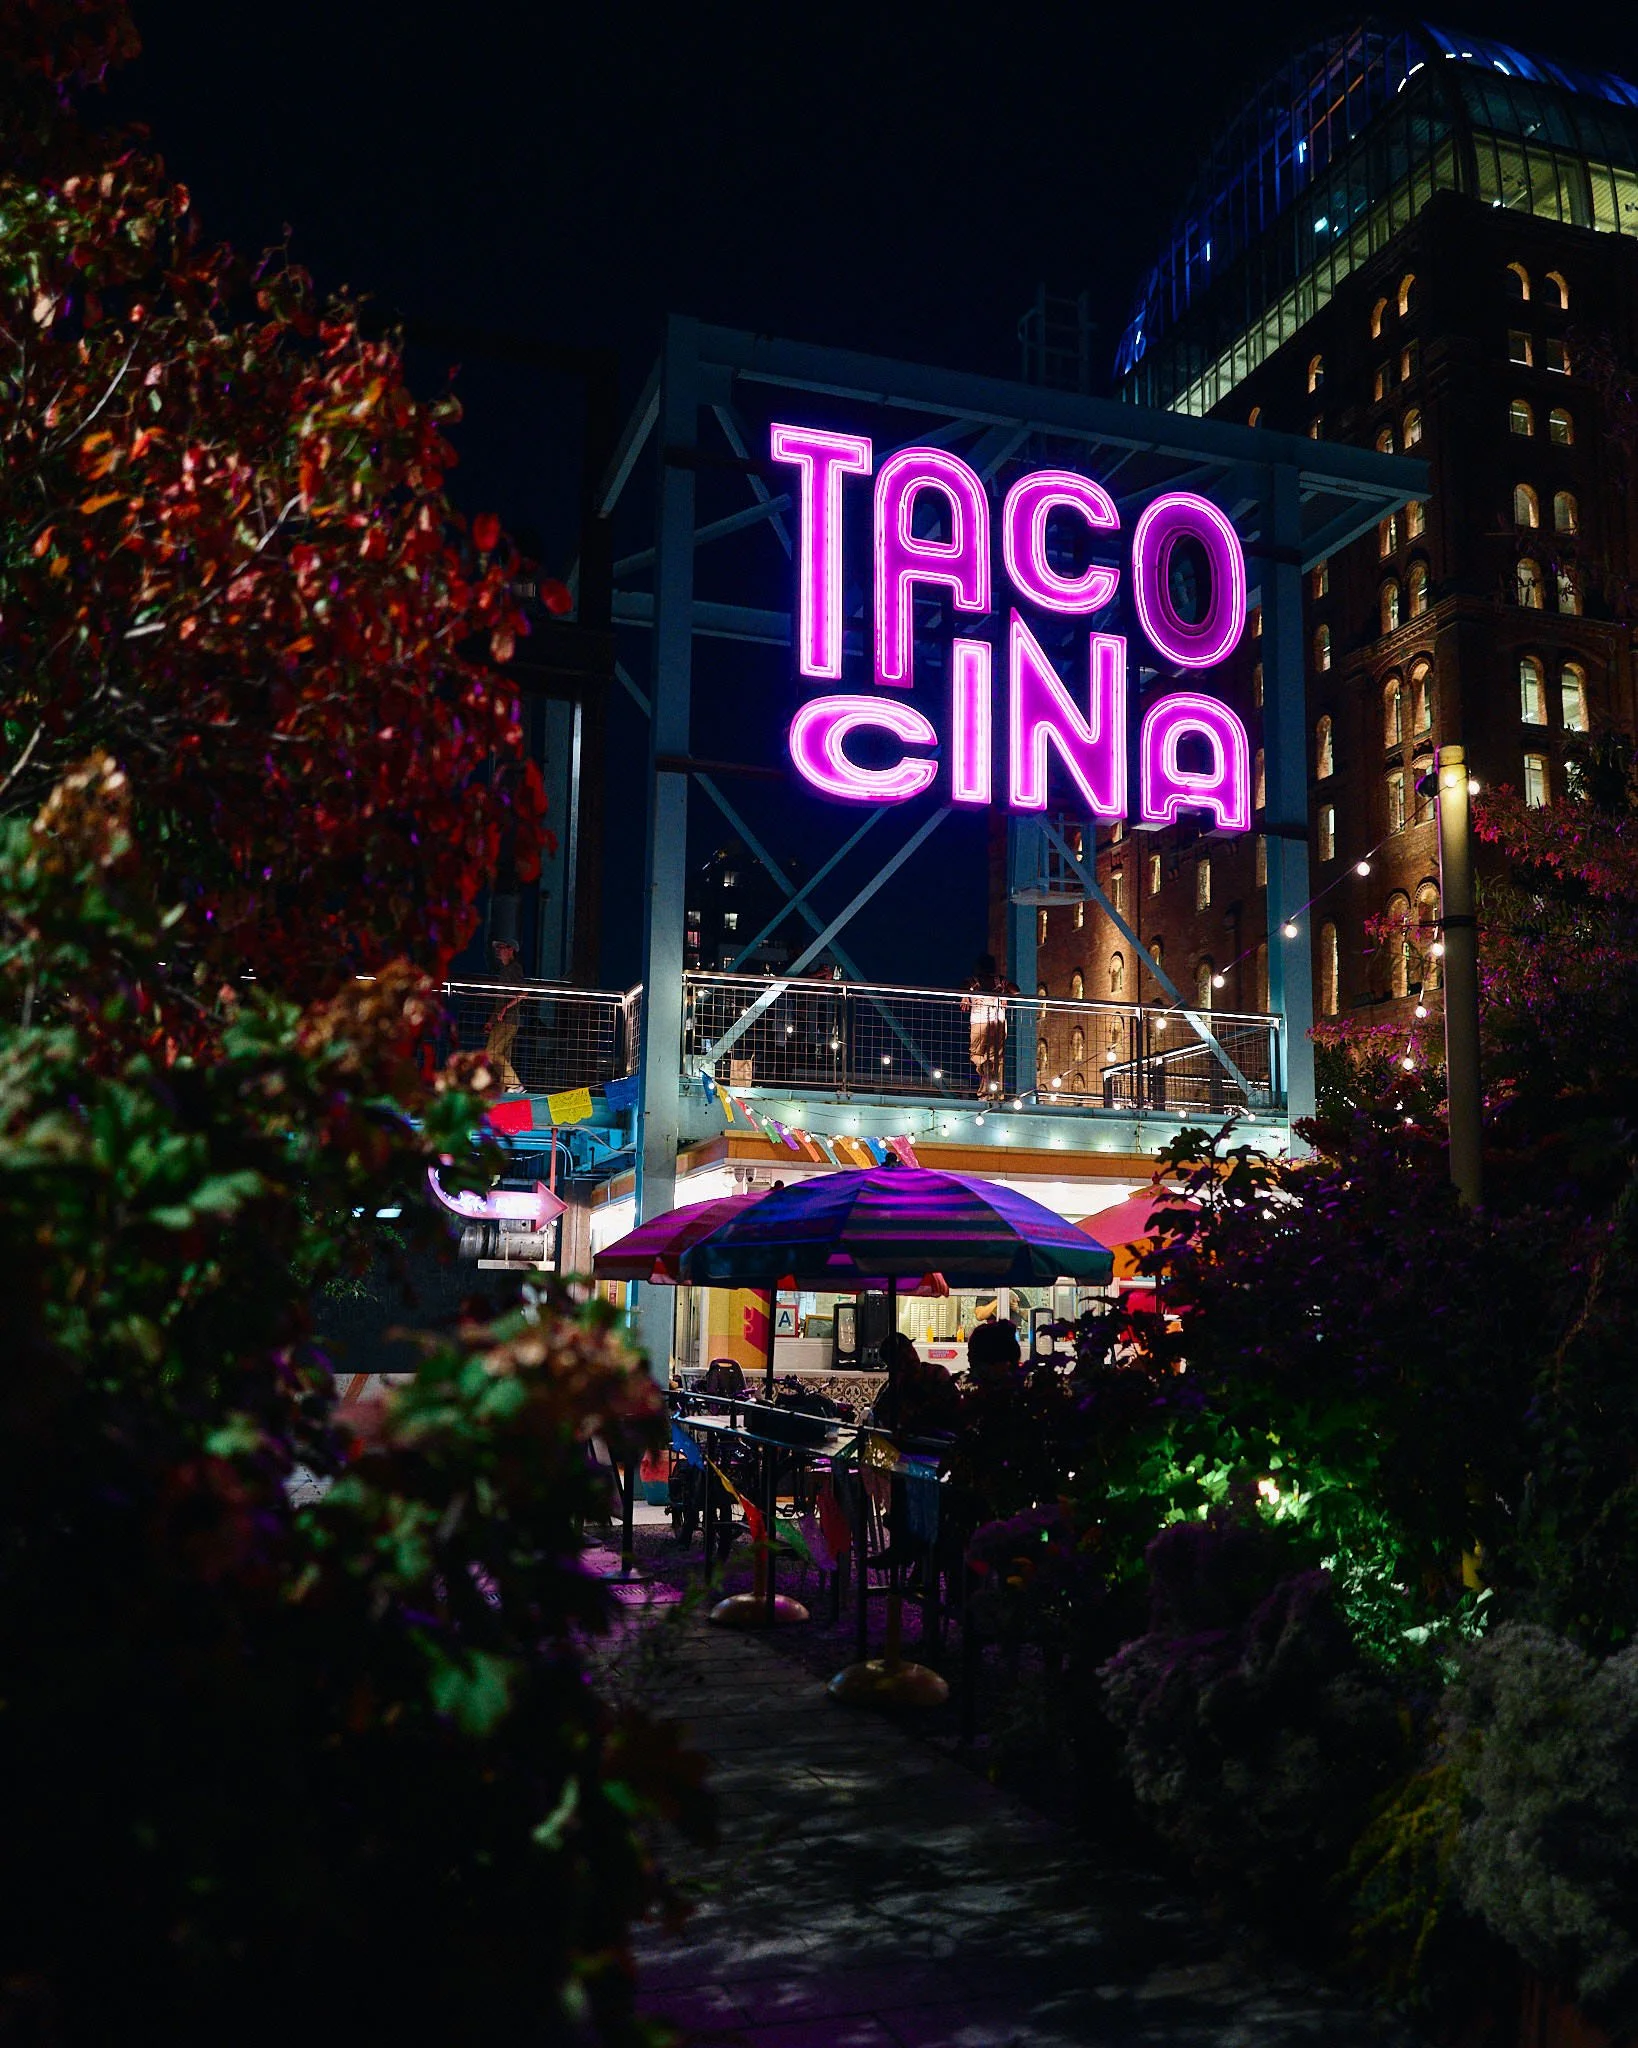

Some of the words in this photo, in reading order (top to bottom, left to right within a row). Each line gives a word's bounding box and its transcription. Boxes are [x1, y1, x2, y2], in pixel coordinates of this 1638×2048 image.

[770, 422, 1247, 689] TACO
[789, 607, 1251, 831] CINA
[778, 1310, 792, 1328] A
